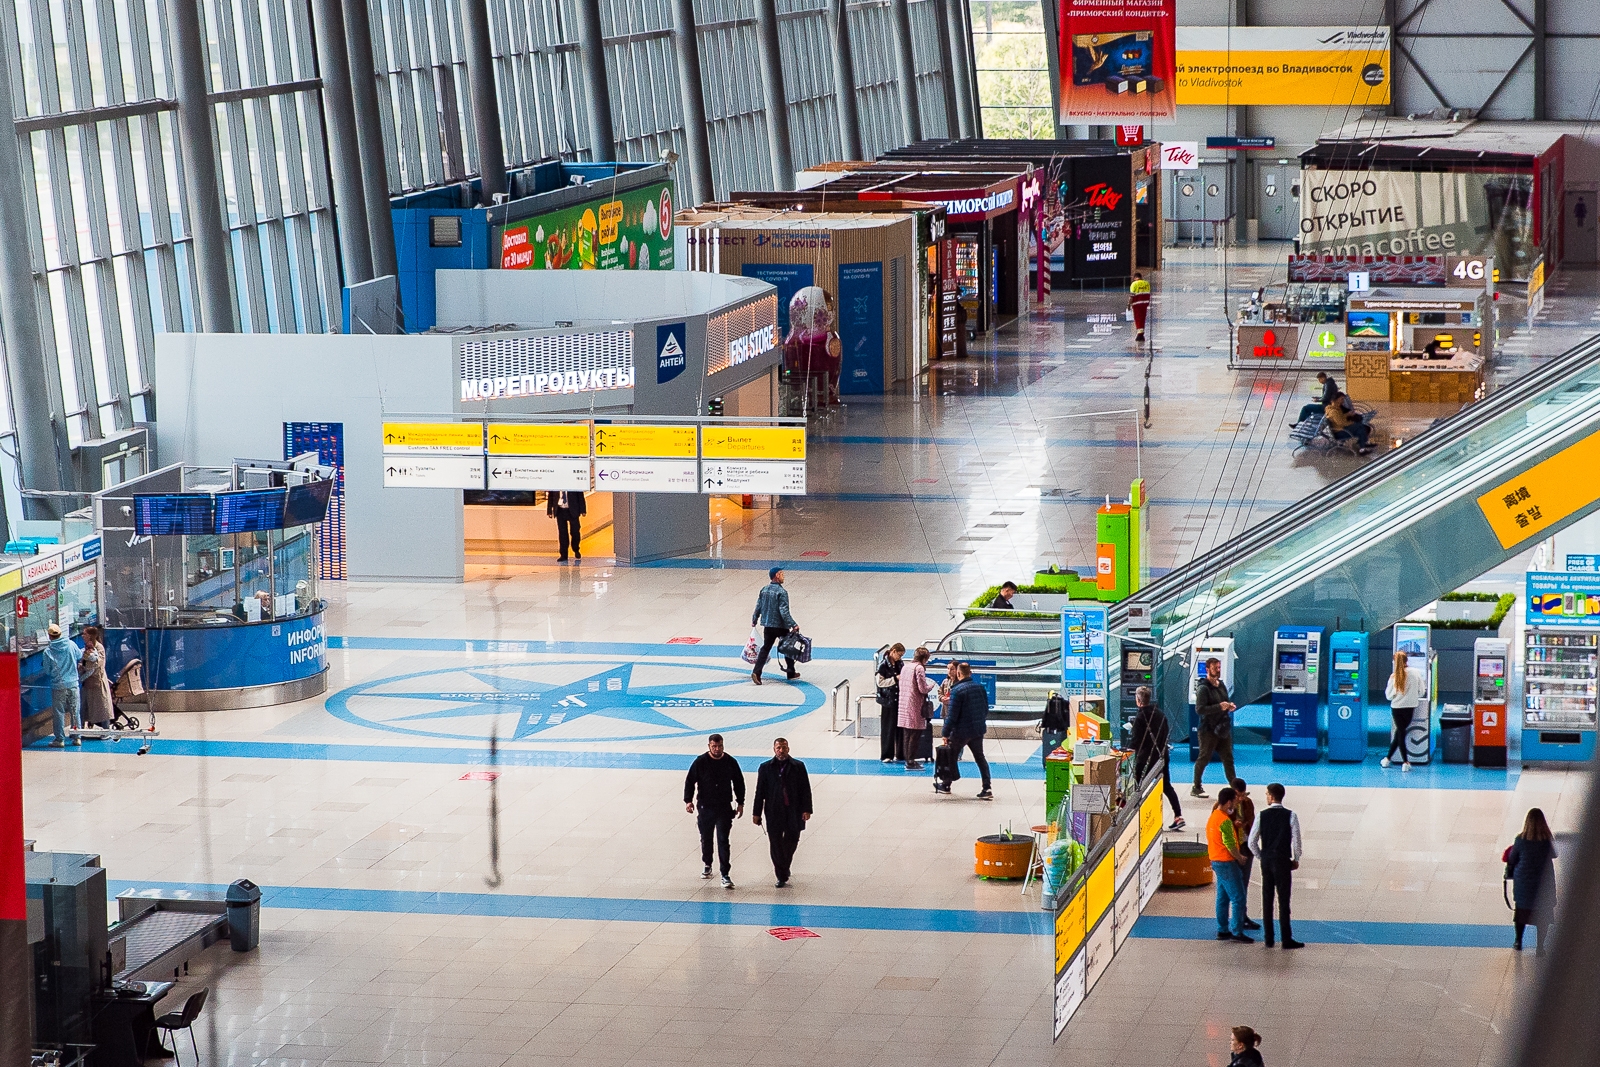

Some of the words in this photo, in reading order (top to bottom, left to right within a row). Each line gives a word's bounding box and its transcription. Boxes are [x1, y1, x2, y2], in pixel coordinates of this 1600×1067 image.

[1347, 31, 1385, 39] Vladivostok
[1188, 65, 1263, 75] электропоезд
[1283, 64, 1353, 75] Владивосток
[1179, 78, 1188, 87] to
[1191, 77, 1243, 87] Vladivostok
[1311, 180, 1377, 203] СКОРО
[1301, 206, 1404, 234] ОТКРЫТИЕ
[503, 232, 527, 250] Доставка
[687, 236, 747, 246] ФАСТЕСТ
[510, 254, 517, 265] 30
[1086, 253, 1100, 261] MINI
[1100, 252, 1118, 260] MART
[1453, 260, 1484, 280] 4G
[730, 335, 749, 367] FISH
[750, 324, 775, 358] STORE
[1253, 345, 1284, 357] МТС
[659, 355, 684, 368] АНТЕЙ
[460, 366, 635, 400] МОРЕПРОДУКТЫ
[727, 443, 765, 451] Departures
[1514, 505, 1543, 528] 출발
[27, 560, 58, 580] АВИАКАССА
[18, 599, 23, 615] 3
[1284, 708, 1299, 717] ВТБ
